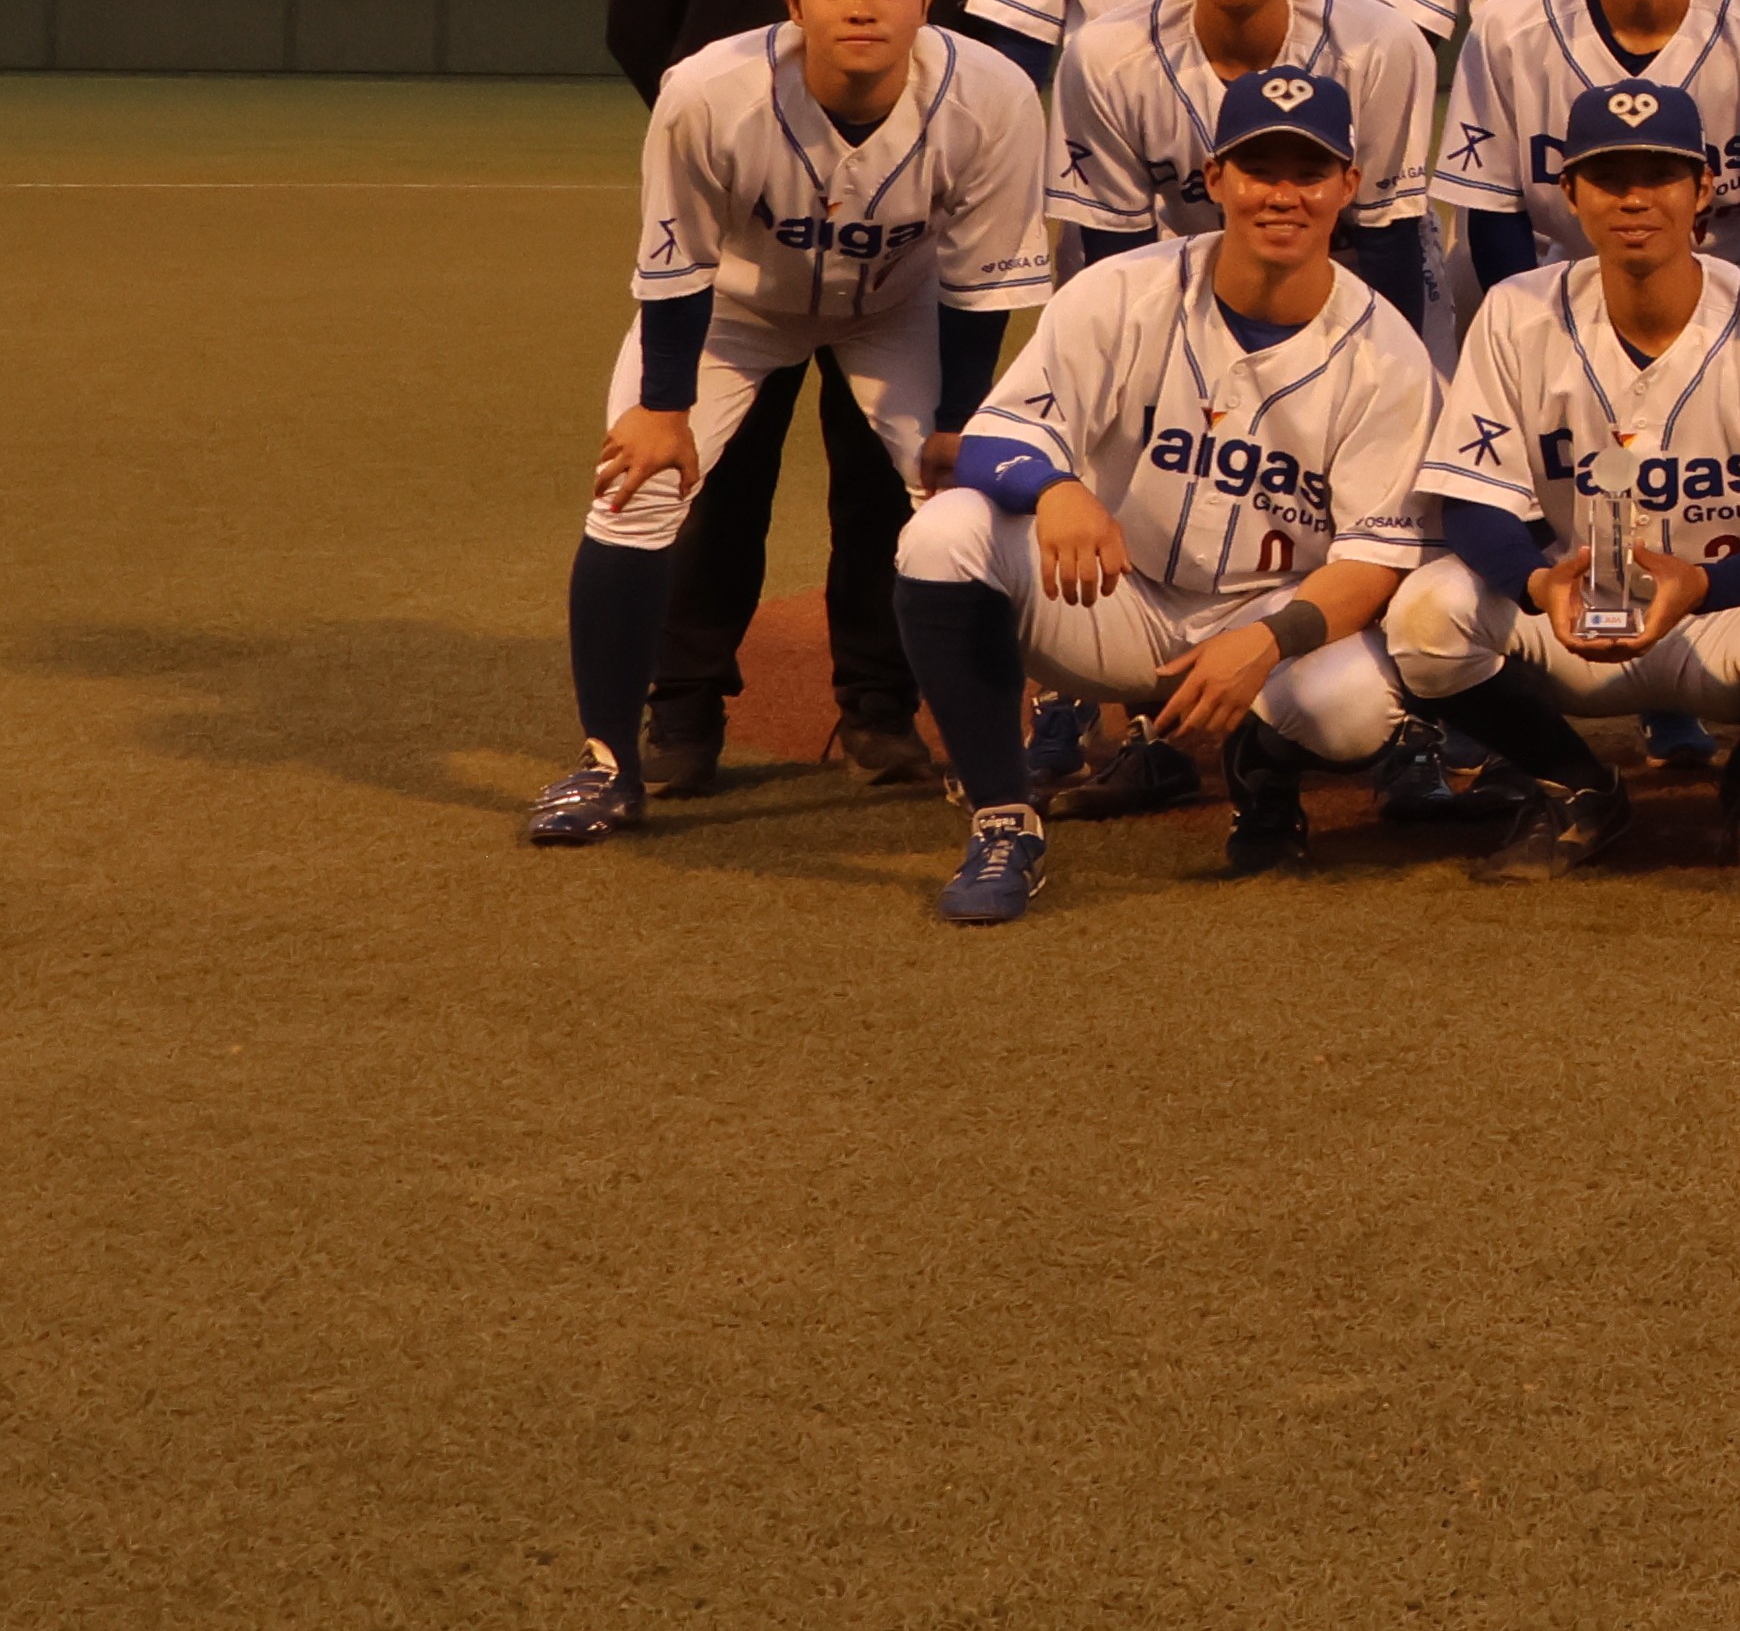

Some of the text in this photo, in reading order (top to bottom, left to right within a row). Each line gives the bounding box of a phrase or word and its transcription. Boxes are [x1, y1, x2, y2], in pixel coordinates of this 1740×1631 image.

[1144, 405, 1327, 511] aigas
[1253, 492, 1328, 534] Group
[1365, 516, 1413, 529] OSAKA
